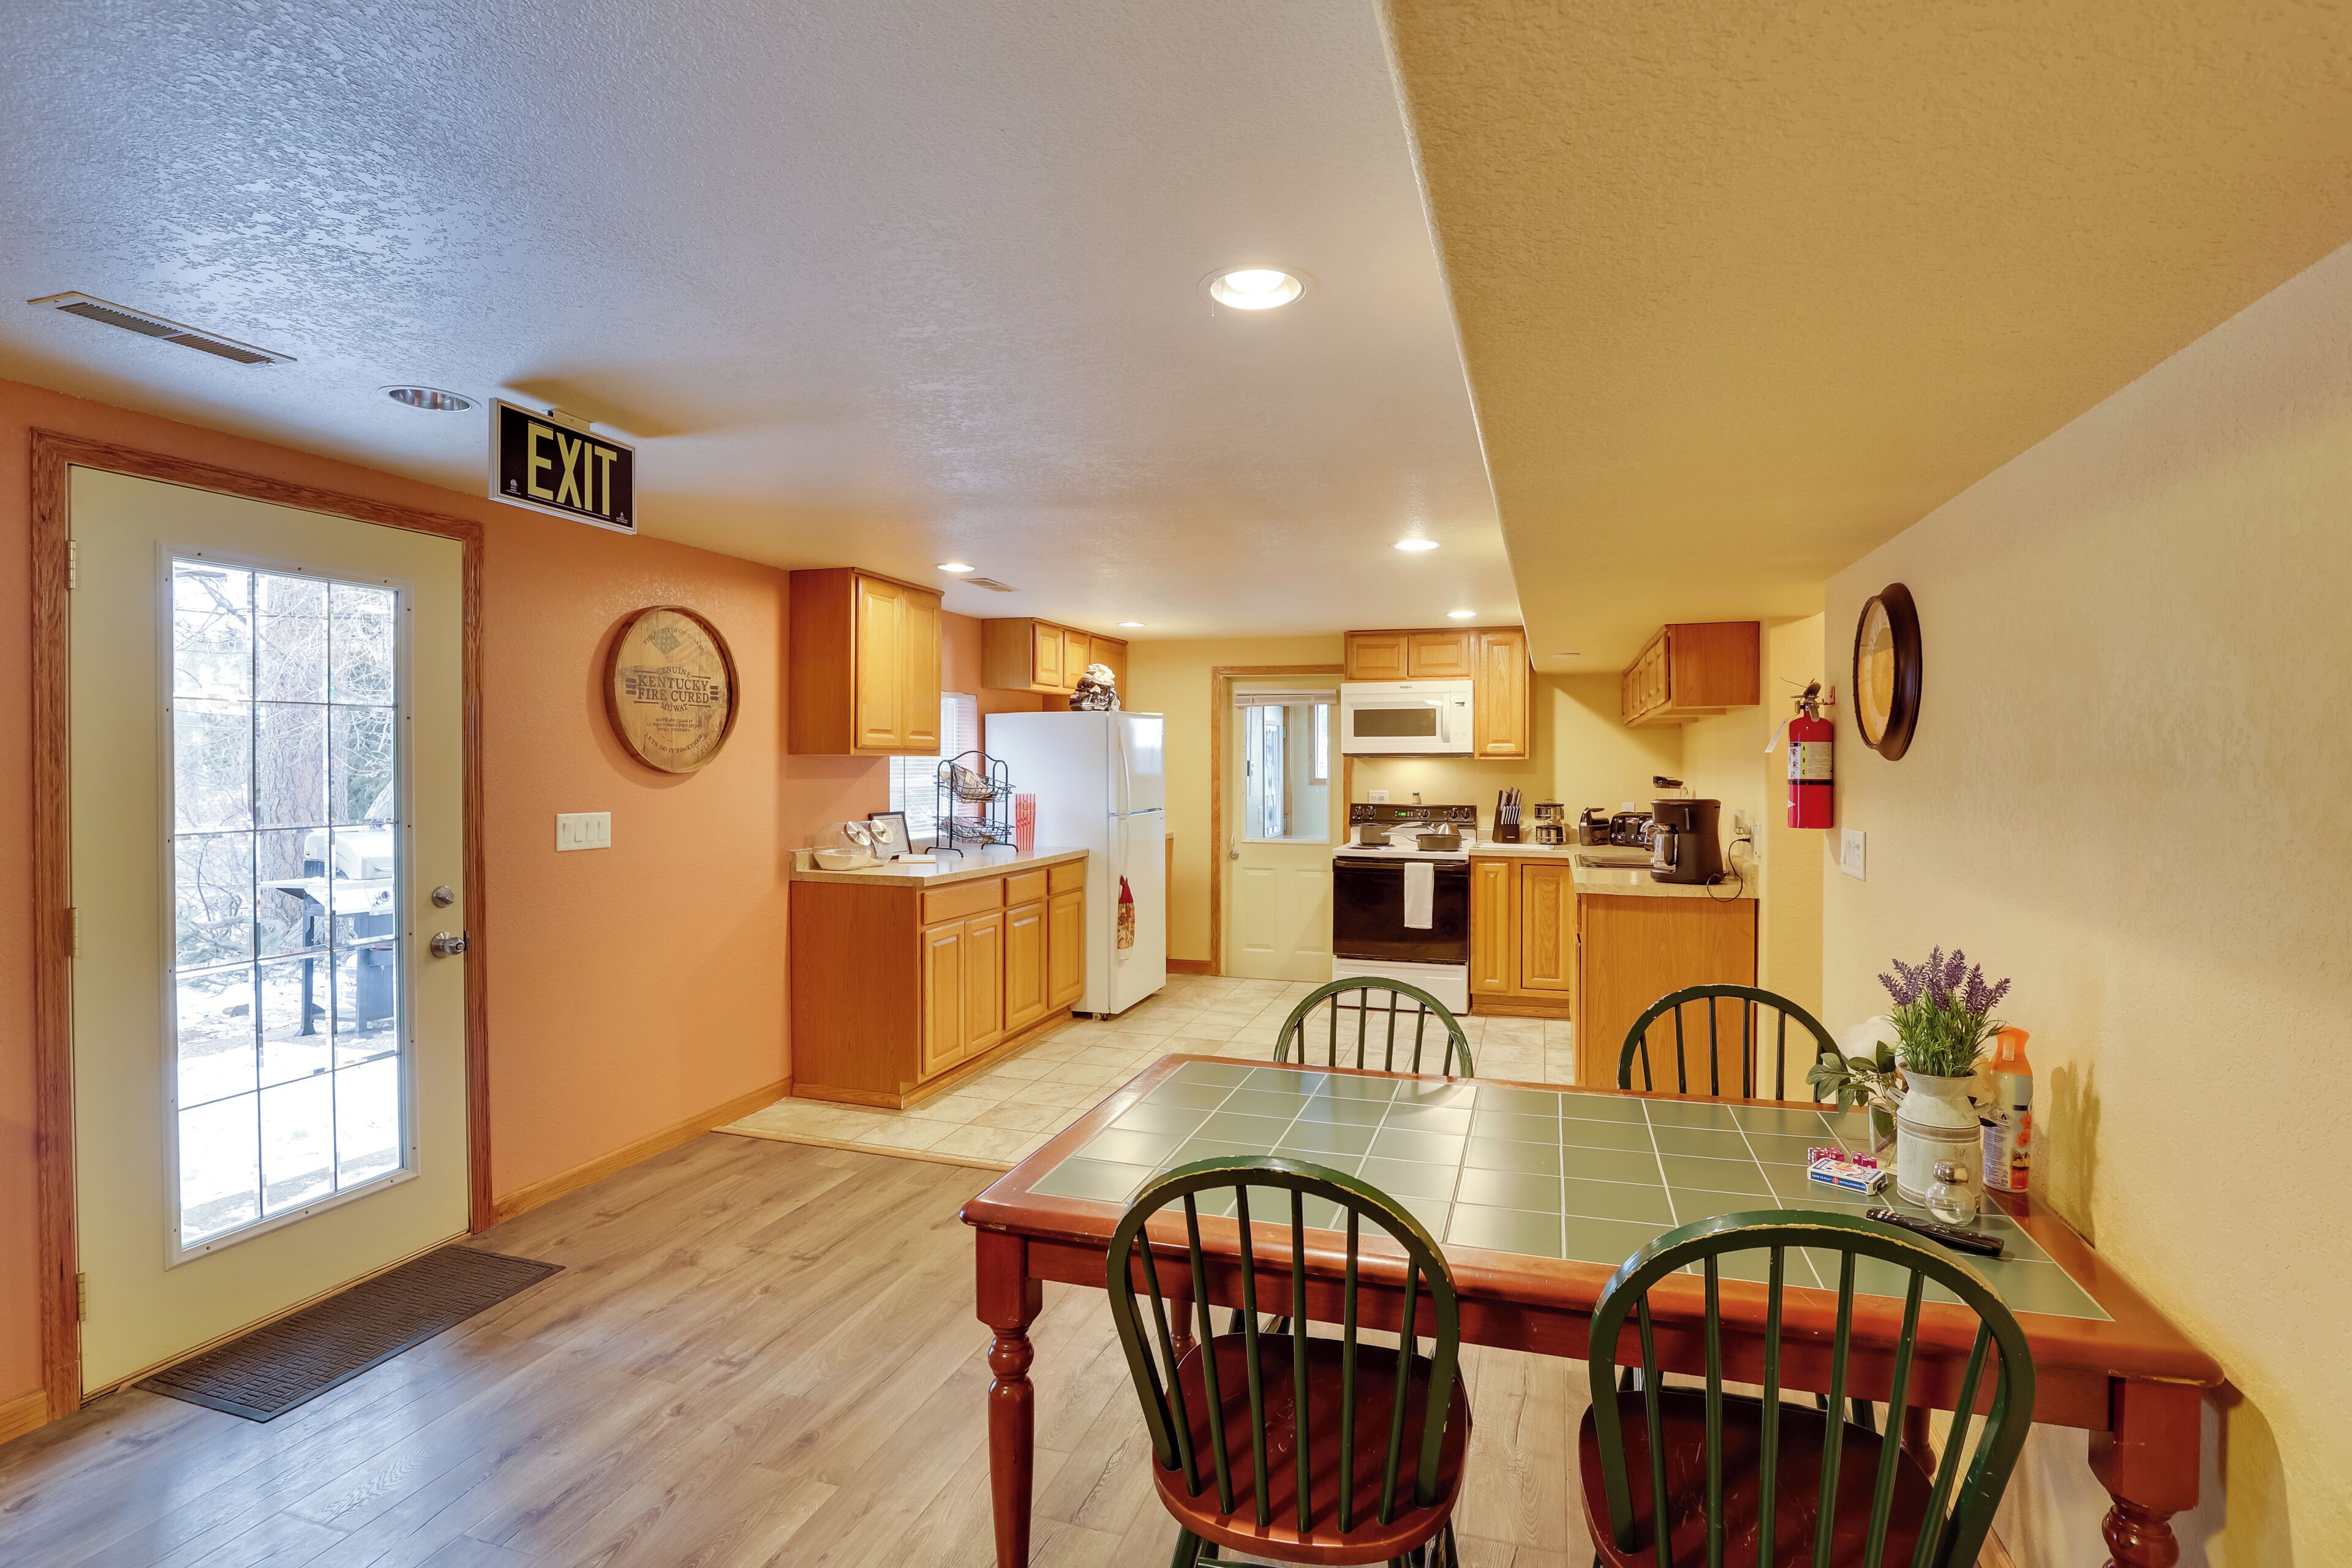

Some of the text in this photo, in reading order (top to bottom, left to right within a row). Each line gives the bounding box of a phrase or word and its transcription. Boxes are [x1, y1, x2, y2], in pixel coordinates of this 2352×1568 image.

[528, 423, 617, 516] EXIT
[643, 633, 655, 645] THE
[654, 627, 677, 638] REBIRTH
[657, 666, 691, 679] GENUINE
[638, 675, 709, 692] KENTUCKY
[637, 687, 709, 704] FIRE CURED
[660, 702, 688, 712] MUWAT
[659, 744, 668, 752] DO
[676, 734, 703, 754] TOGETHER
